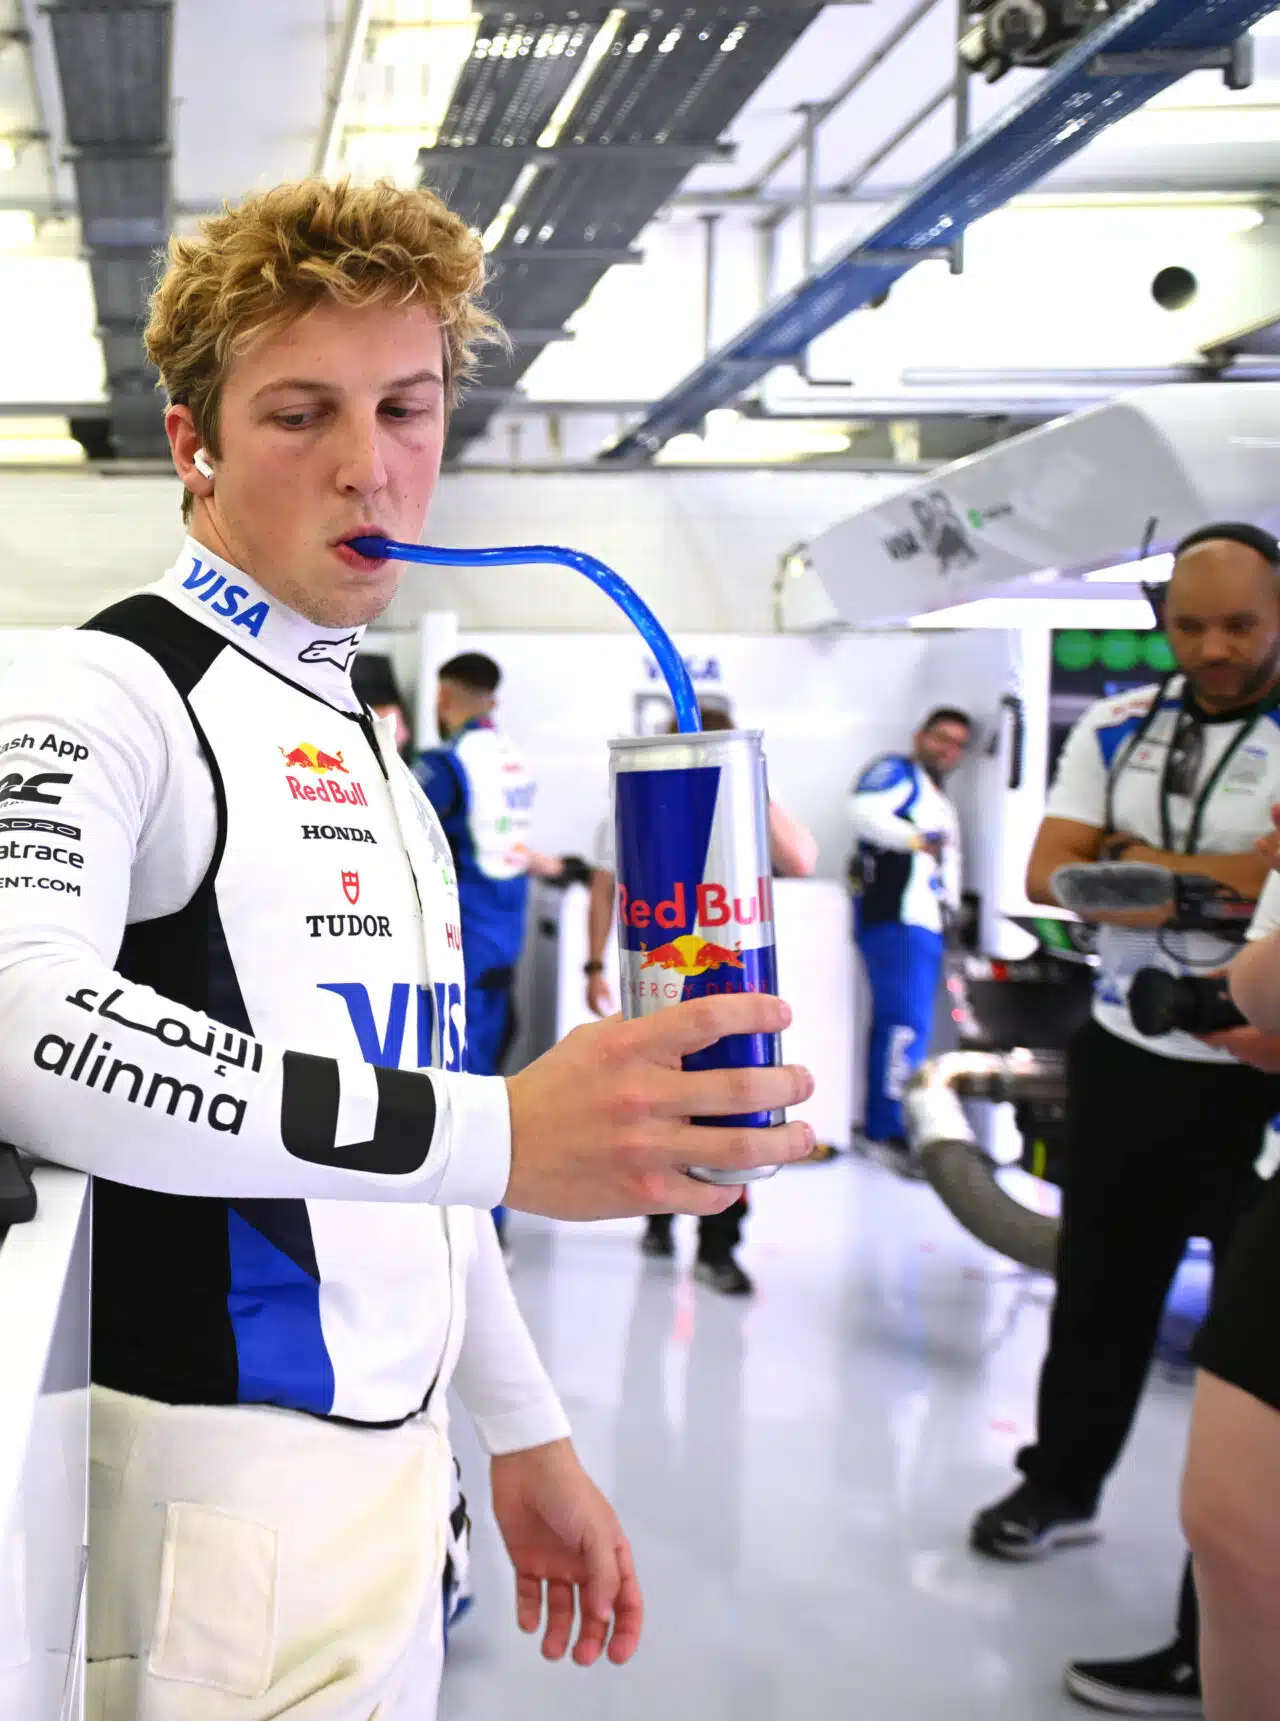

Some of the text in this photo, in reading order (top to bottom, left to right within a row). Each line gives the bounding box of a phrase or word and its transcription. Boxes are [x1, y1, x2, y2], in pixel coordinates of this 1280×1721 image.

[182, 557, 270, 638] VISA
[39, 734, 89, 762] App
[300, 824, 378, 844] HONDA
[306, 914, 392, 938] TUDOR
[617, 881, 687, 929] Red
[316, 982, 470, 1075] VIS
[33, 1031, 249, 1136] alinma
